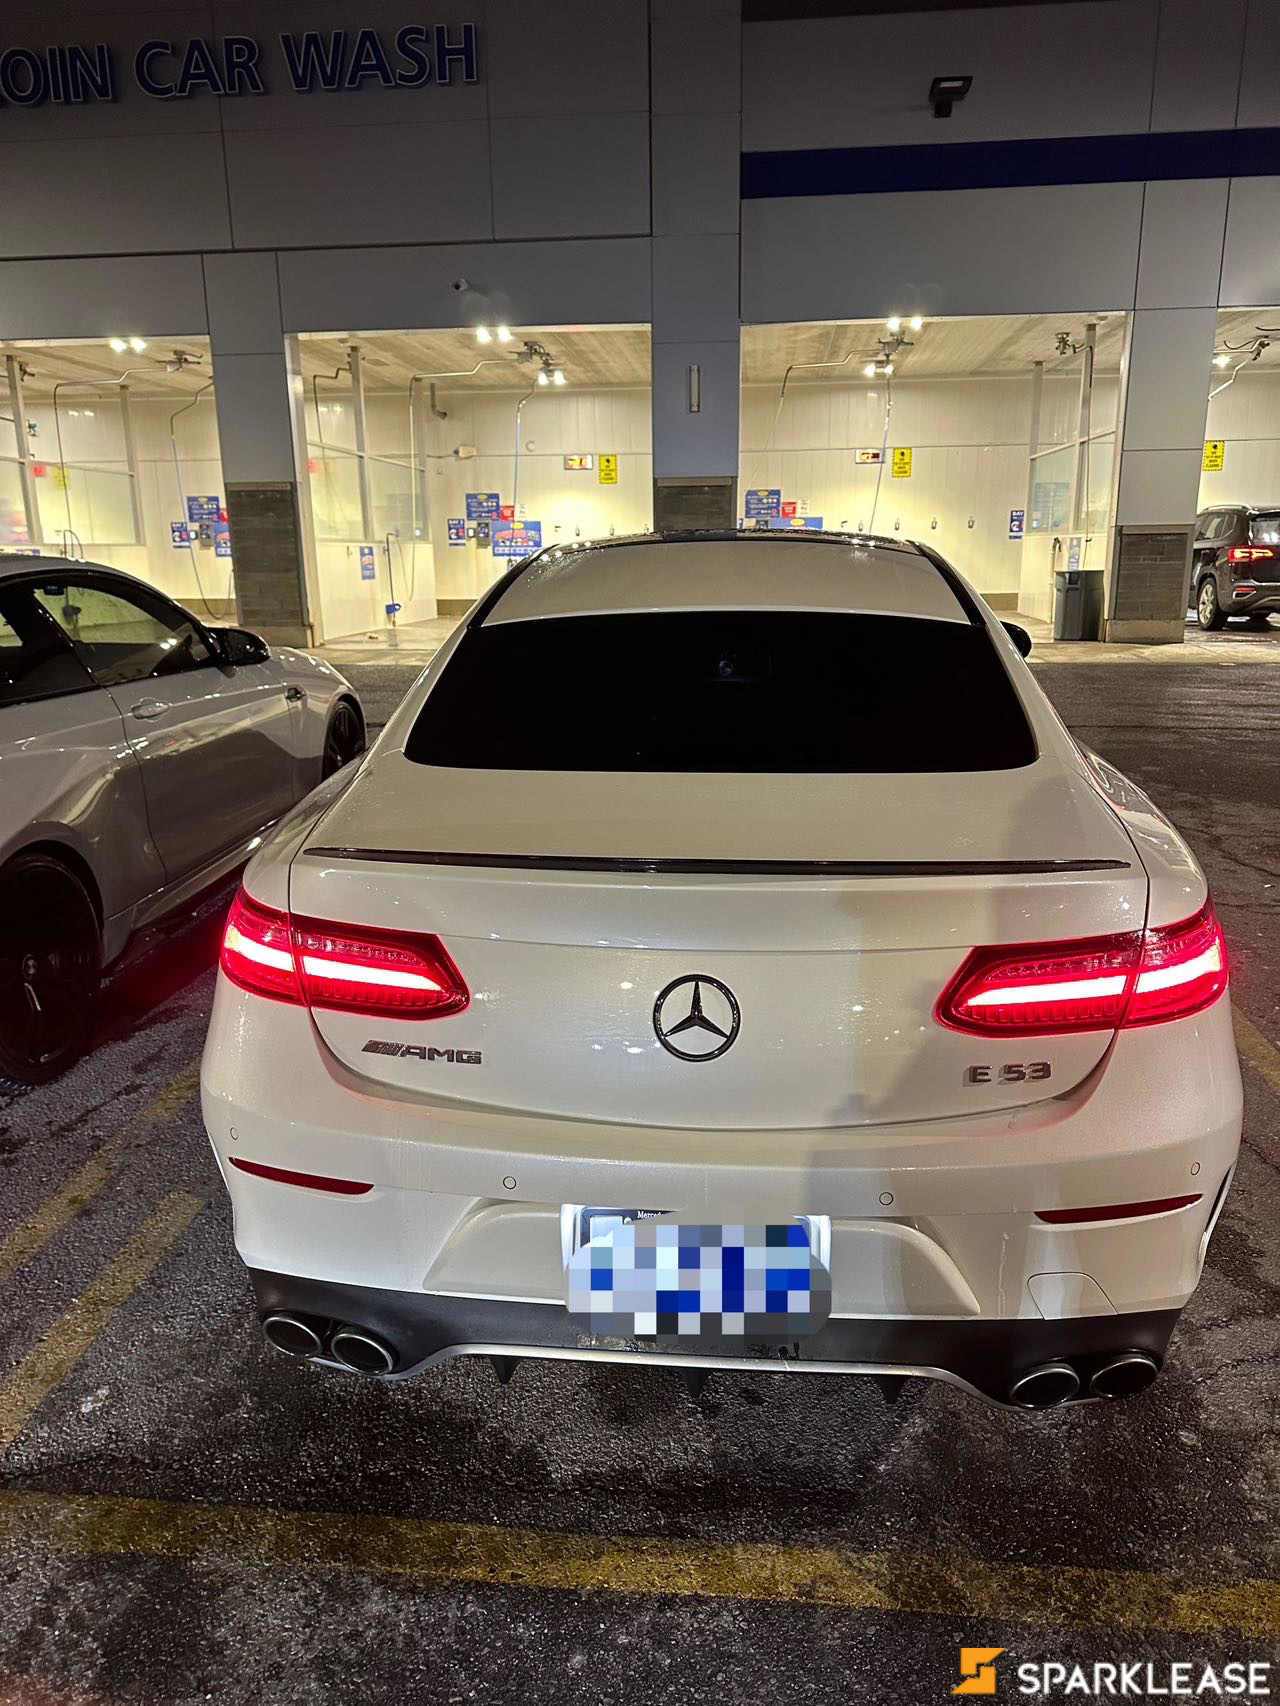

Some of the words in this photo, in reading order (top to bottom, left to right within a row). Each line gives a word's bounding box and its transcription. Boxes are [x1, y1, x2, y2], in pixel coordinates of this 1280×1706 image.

[134, 36, 264, 98] CAR
[280, 23, 478, 90] WASH
[400, 1044, 482, 1065] AMG
[967, 1064, 993, 1083] E
[1002, 1061, 1052, 1082] 53
